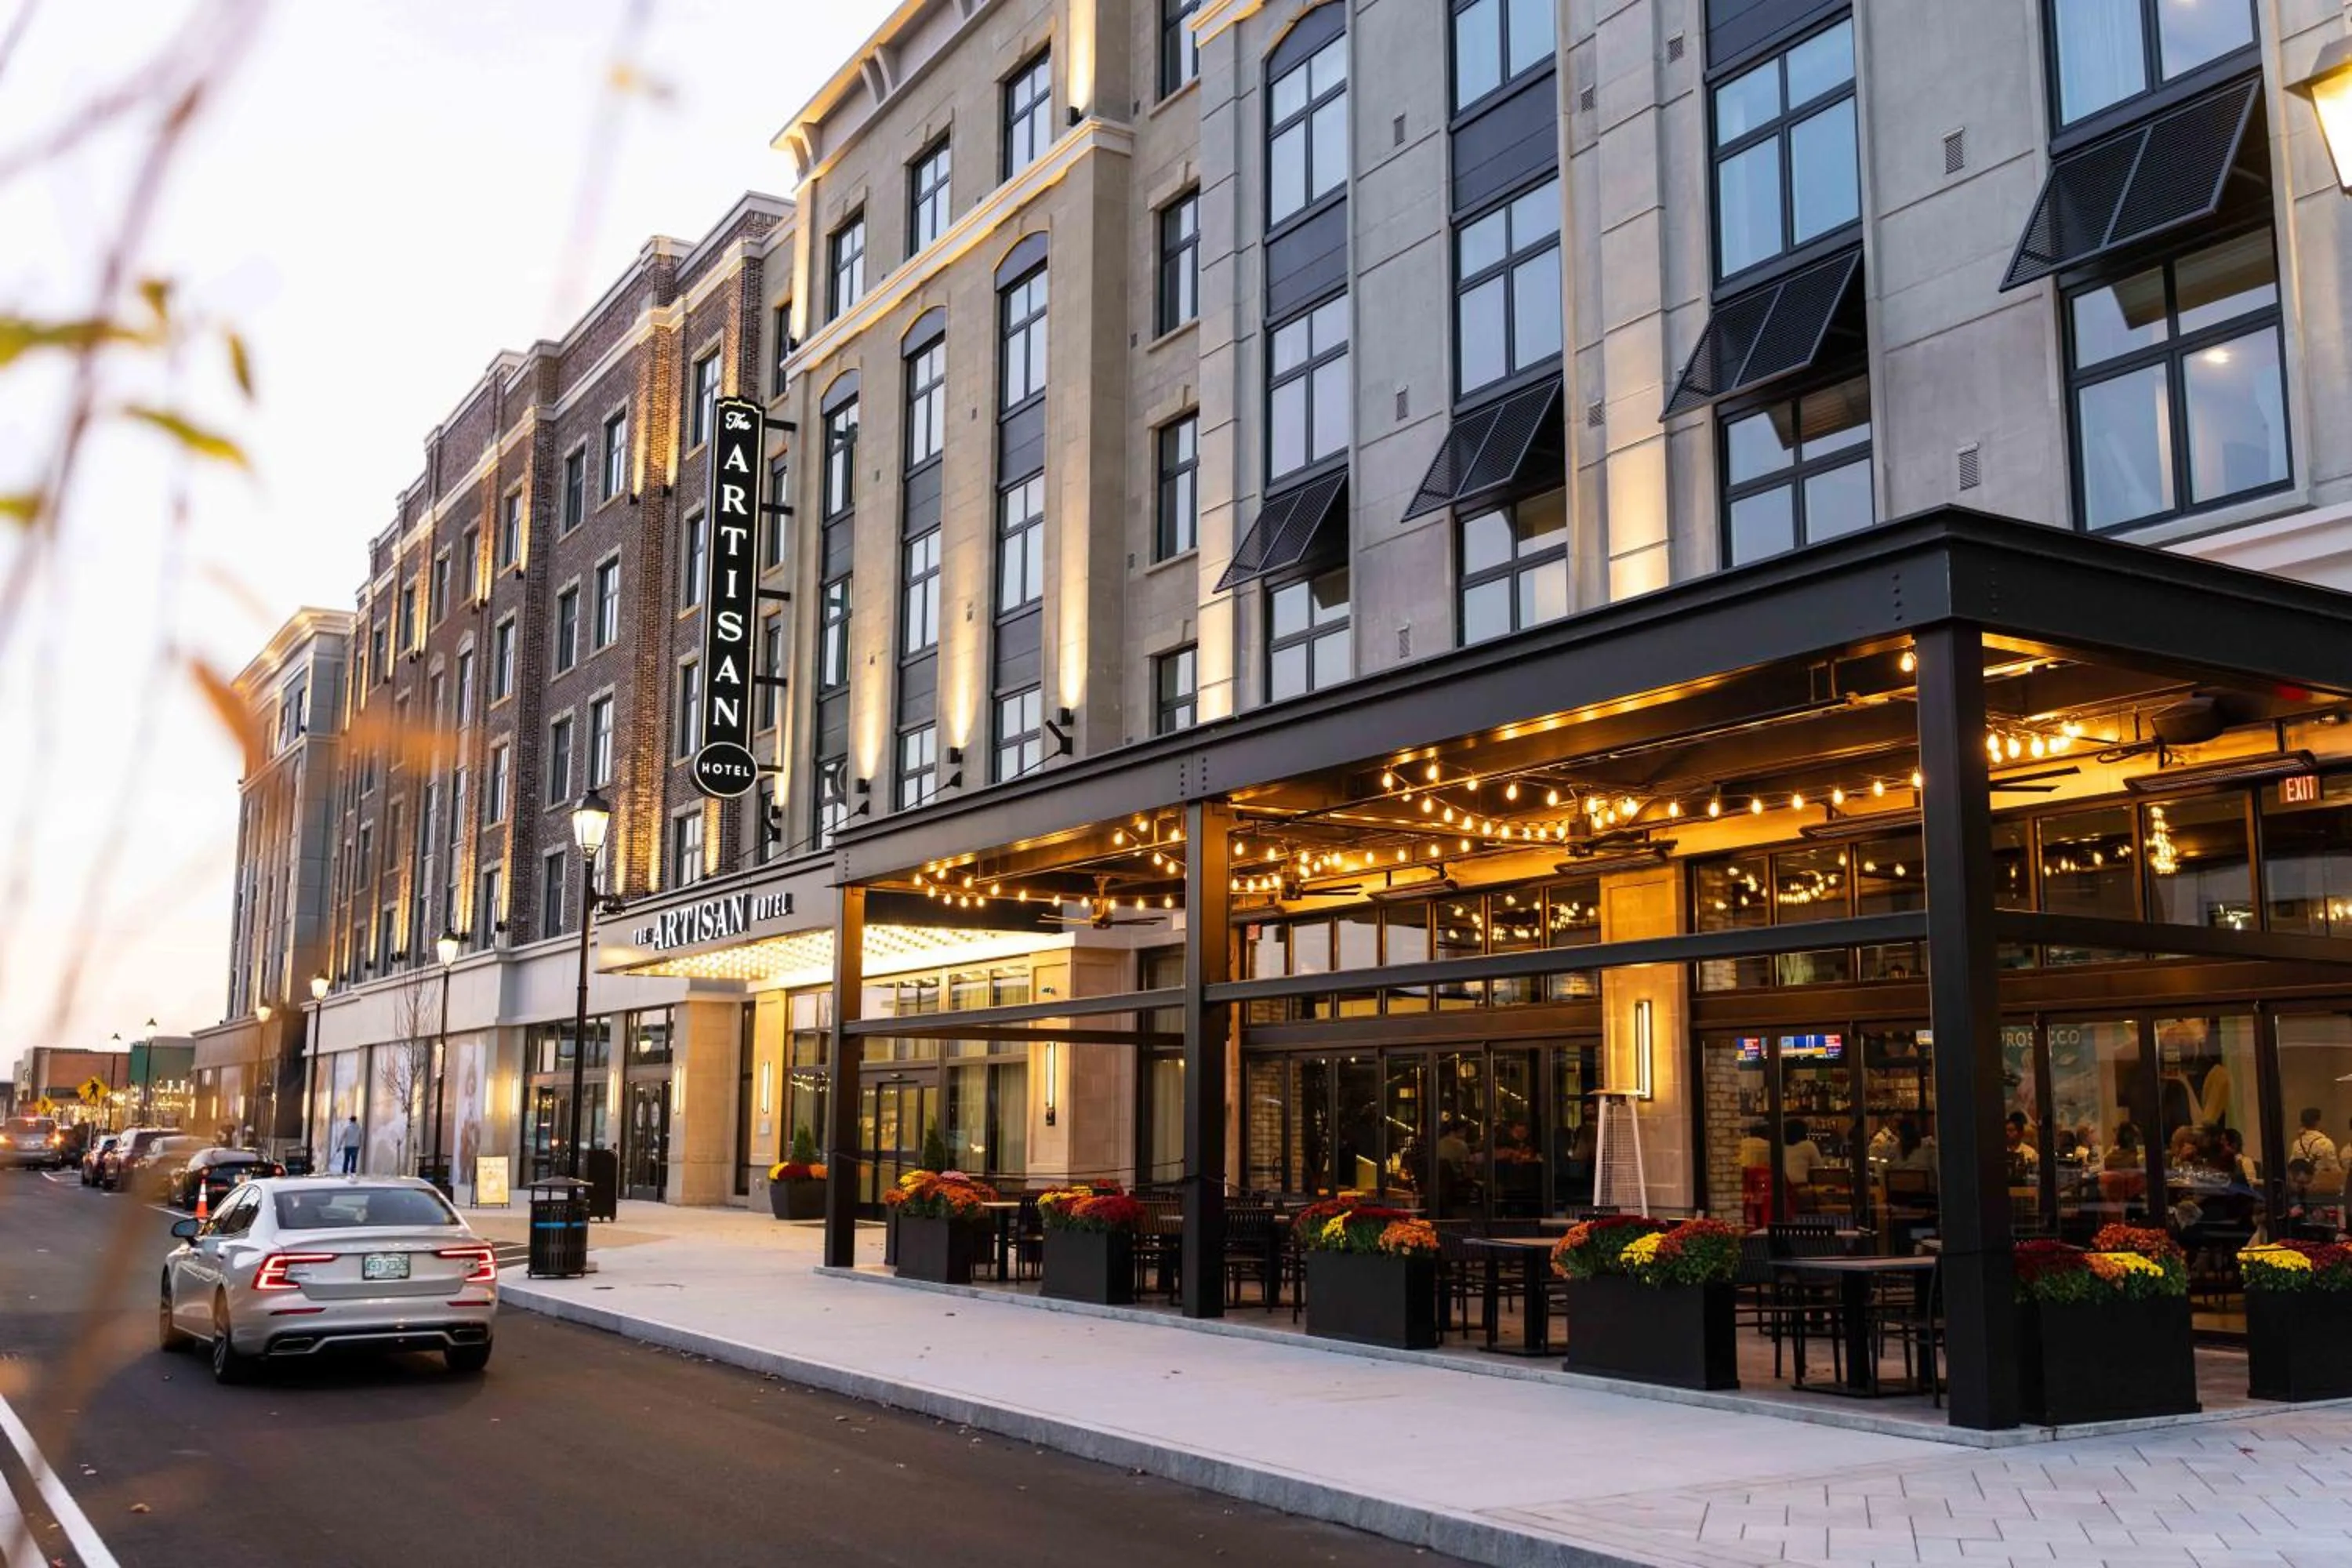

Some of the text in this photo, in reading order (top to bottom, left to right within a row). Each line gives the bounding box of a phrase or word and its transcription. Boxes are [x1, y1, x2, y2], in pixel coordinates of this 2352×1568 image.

[725, 411, 752, 430] The
[713, 443, 750, 728] ARTISAN
[702, 761, 750, 778] HOTEL
[2285, 775, 2314, 802] EXIT
[652, 892, 746, 951] ARTISAN
[752, 892, 787, 921] HOTEL
